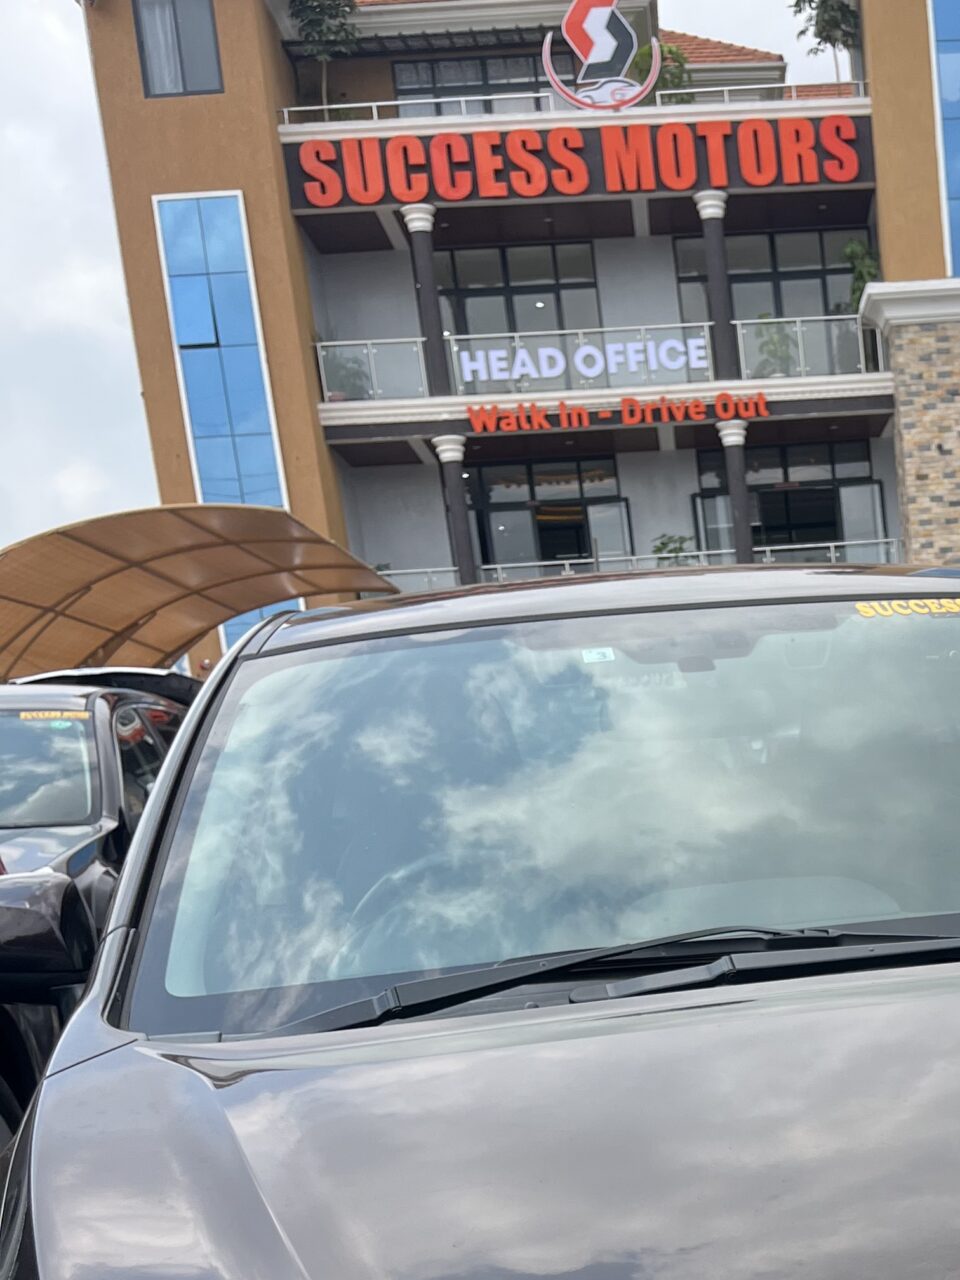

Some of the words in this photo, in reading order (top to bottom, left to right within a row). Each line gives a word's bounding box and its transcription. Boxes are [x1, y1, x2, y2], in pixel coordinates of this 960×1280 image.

[299, 126, 591, 207] SUCCESS
[601, 115, 860, 192] MOTORS
[460, 346, 566, 382] HEAD
[573, 338, 709, 377] OFFICE
[467, 402, 551, 434] Walk
[558, 400, 590, 428] In
[621, 396, 706, 425] Drive
[715, 391, 770, 419] Out
